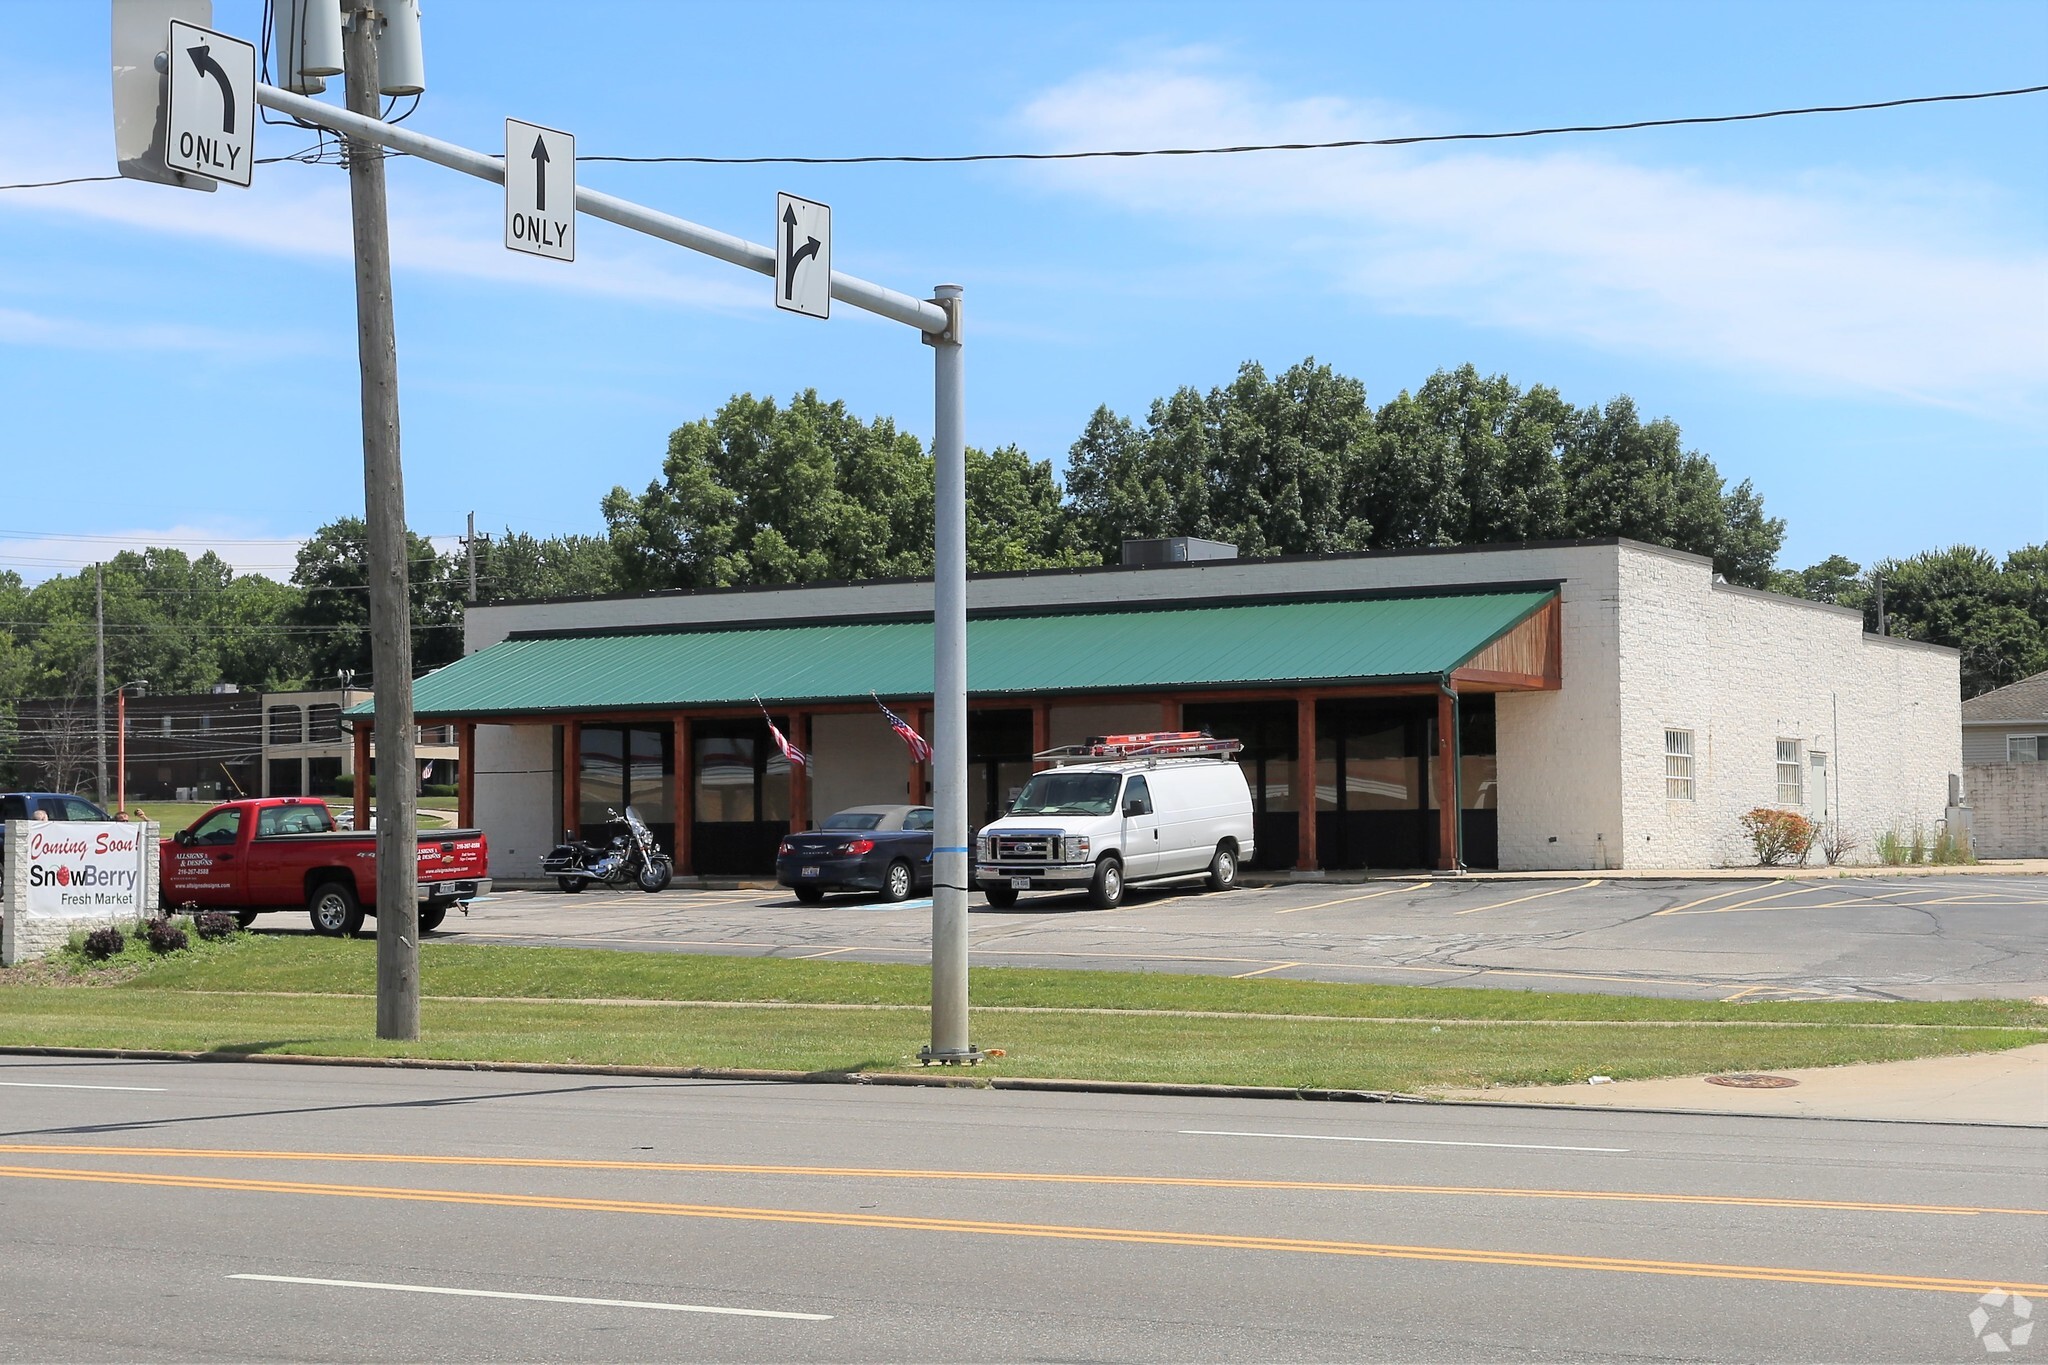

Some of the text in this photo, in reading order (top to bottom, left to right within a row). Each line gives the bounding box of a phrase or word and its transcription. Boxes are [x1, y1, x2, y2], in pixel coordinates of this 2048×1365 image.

[180, 131, 241, 171] ONLY
[512, 212, 568, 248] ONLY
[30, 831, 140, 861] Coming Soon!
[187, 859, 213, 867] DESIGNS
[61, 892, 133, 905] Fresh Market
